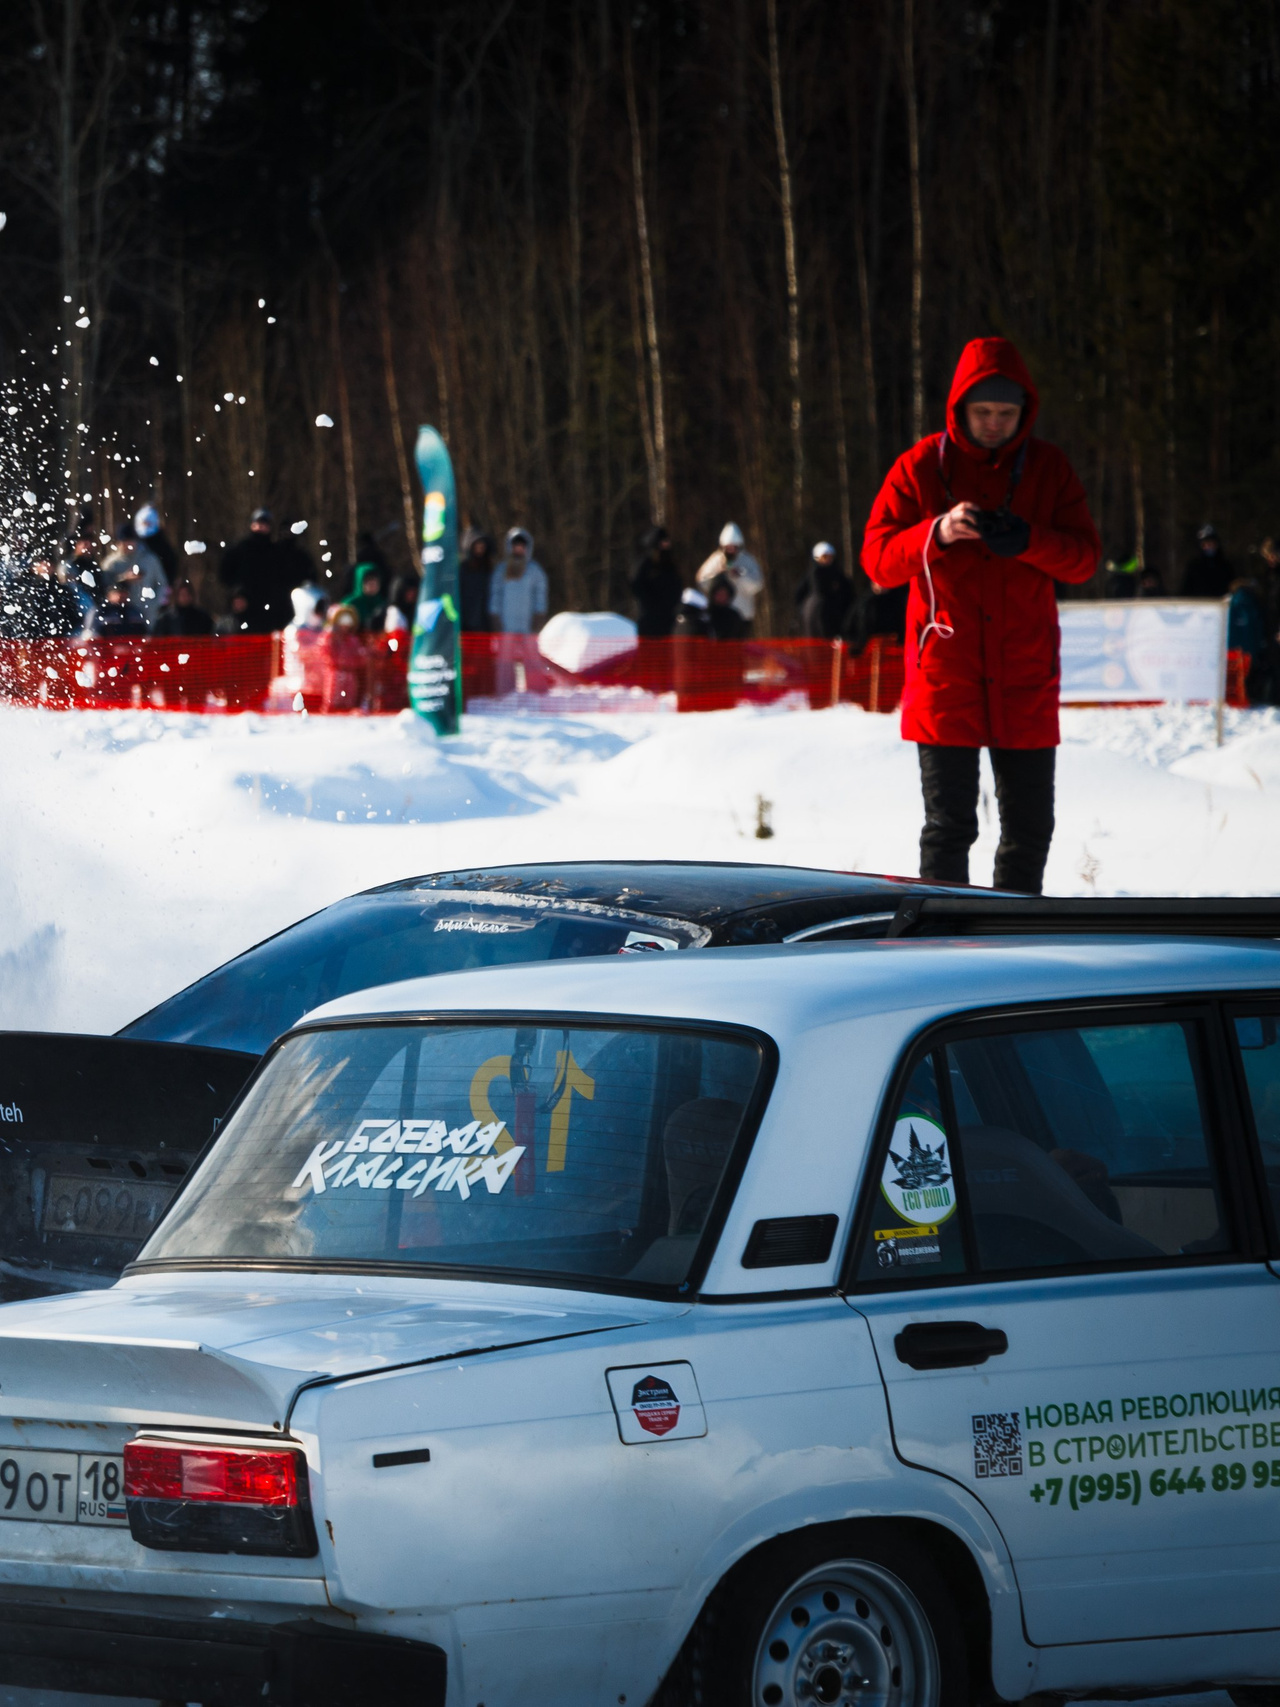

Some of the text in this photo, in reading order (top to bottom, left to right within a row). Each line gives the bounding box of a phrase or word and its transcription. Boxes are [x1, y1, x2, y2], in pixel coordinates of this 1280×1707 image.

[344, 1119, 507, 1155] БОЕВАЯ
[902, 1186, 951, 1211] ECO BUILD
[1024, 1386, 1280, 1429] НОВАЯ РЕВОЛЮЦИЯ
[1028, 1421, 1280, 1467] В СТРОИТЕЛЬСТВЕ
[85, 1461, 124, 1501] 18
[1029, 1460, 1280, 1510] +7 (995) 644 89 95
[79, 1501, 106, 1517] RUS
